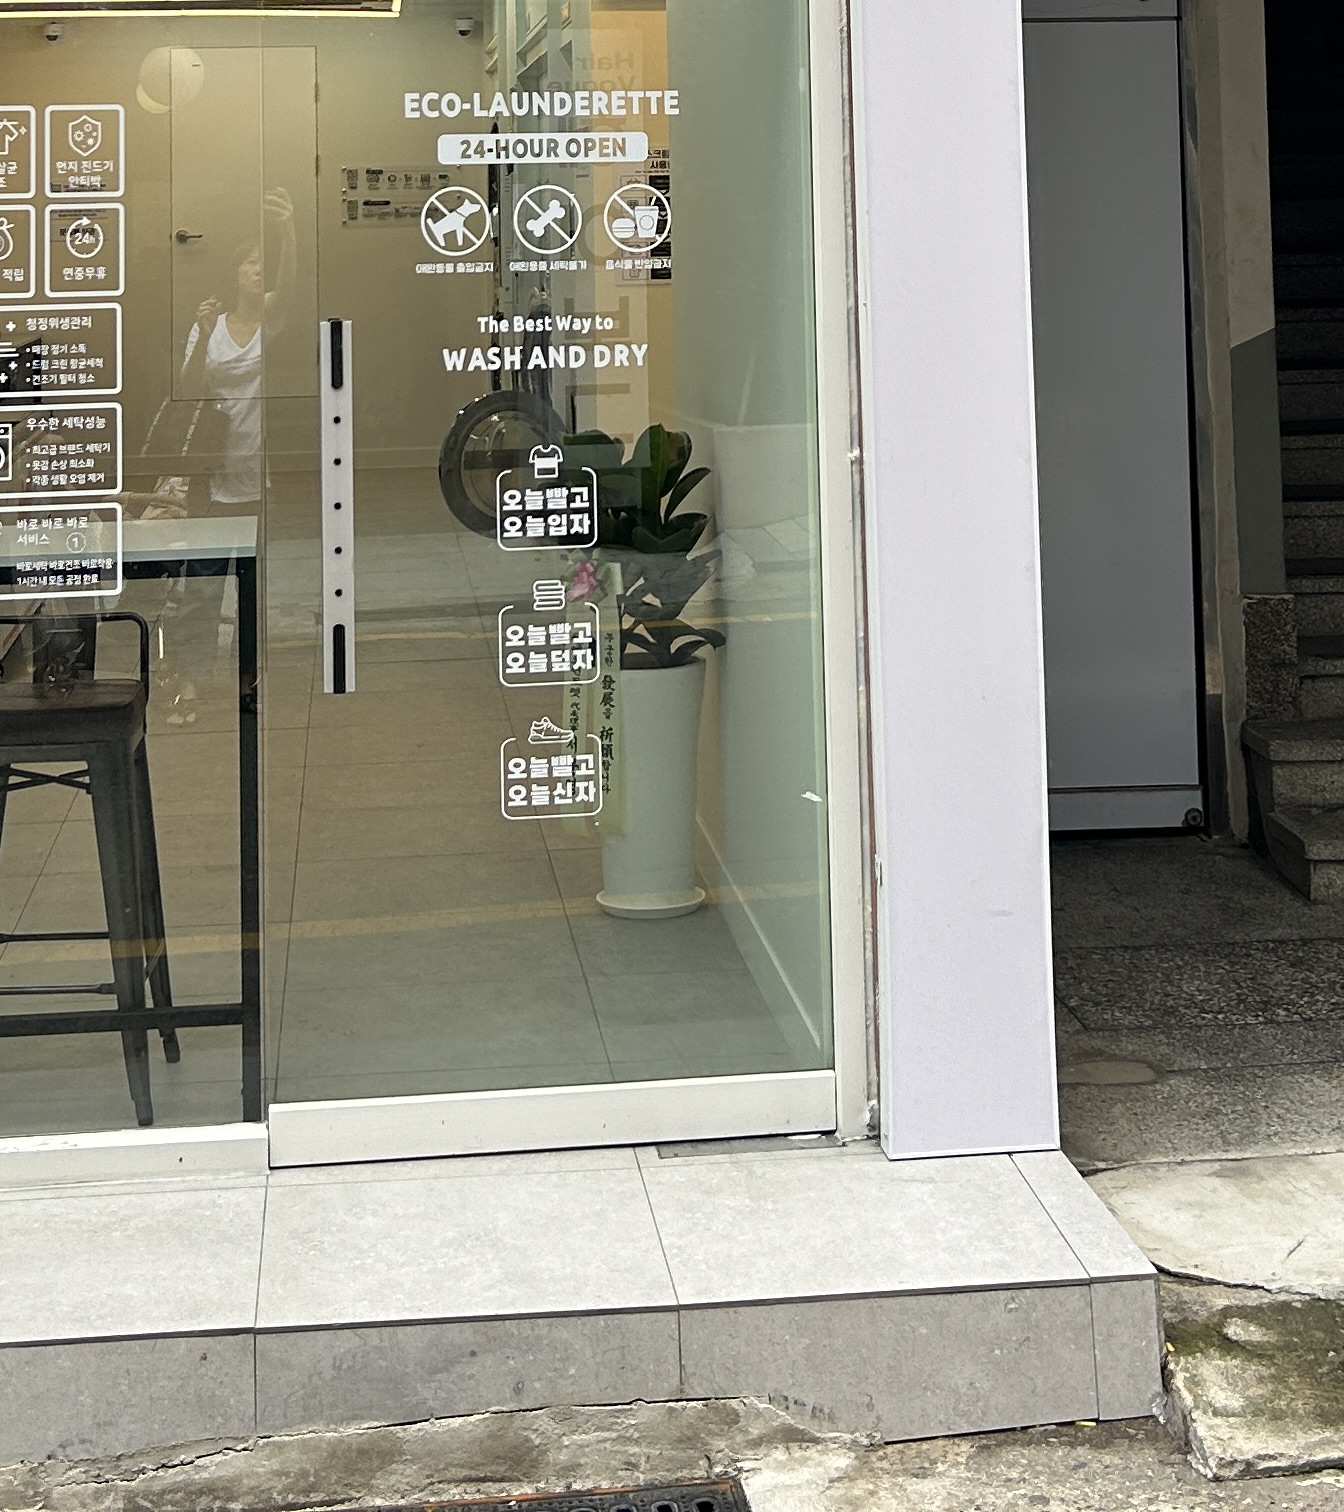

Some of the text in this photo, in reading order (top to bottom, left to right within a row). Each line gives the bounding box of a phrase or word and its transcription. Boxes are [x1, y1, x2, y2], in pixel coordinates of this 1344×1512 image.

[403, 89, 681, 119] ECO-LAUNDERETTE
[460, 137, 560, 160] 24-HOUR
[569, 136, 628, 159] OPEN
[57, 159, 114, 175] 먼지 진드기
[1, 267, 25, 282] 적립
[62, 266, 108, 281] 연중무휴
[477, 314, 614, 334] The Best Way to
[442, 343, 648, 372] WASH AND DRY
[502, 485, 591, 512] 오늘빨고
[16, 516, 89, 532] 바로 바로 바로
[502, 512, 591, 539] 오늘입자
[16, 533, 51, 546] 서비스
[505, 620, 595, 648] 오늘빨고
[505, 648, 596, 676] 오늘덮자
[507, 753, 597, 780] 오늘빨고
[507, 780, 598, 808] 오늘신자
